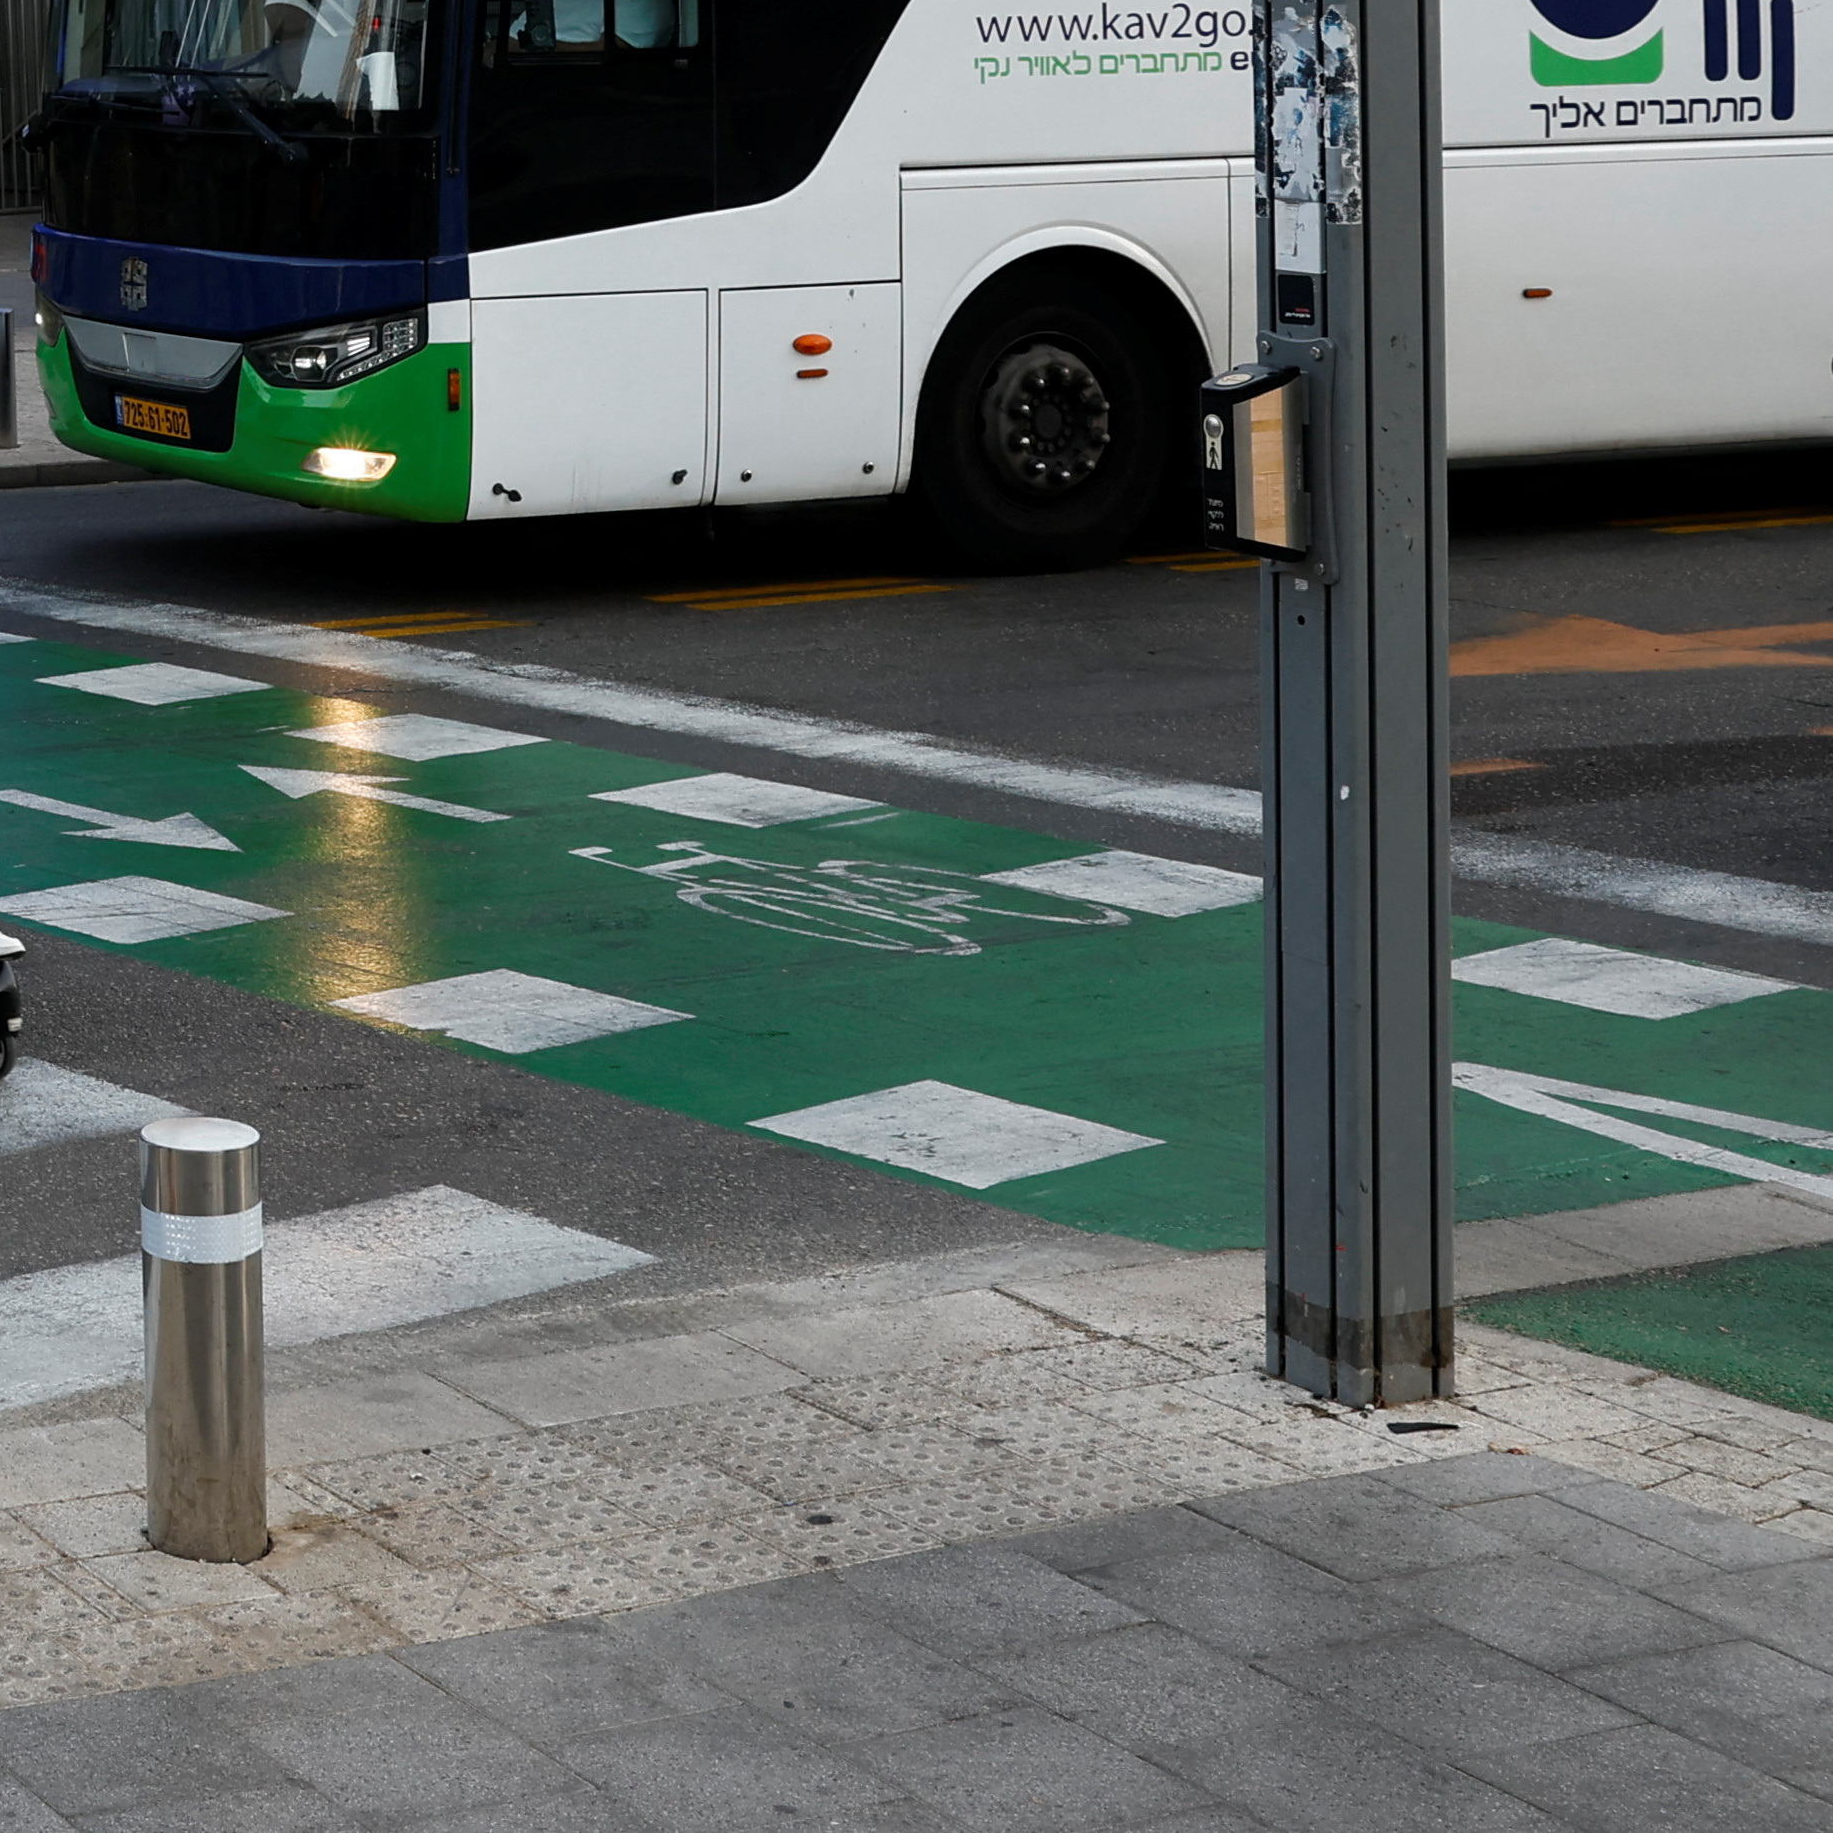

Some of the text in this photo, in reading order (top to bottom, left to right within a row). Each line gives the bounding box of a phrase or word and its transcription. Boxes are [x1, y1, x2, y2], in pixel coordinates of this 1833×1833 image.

[976, 2, 1255, 48] www.kav2go.
[974, 50, 1222, 84] מתחברים לאוויר נקי
[1530, 95, 1762, 138] מתחברים אליך
